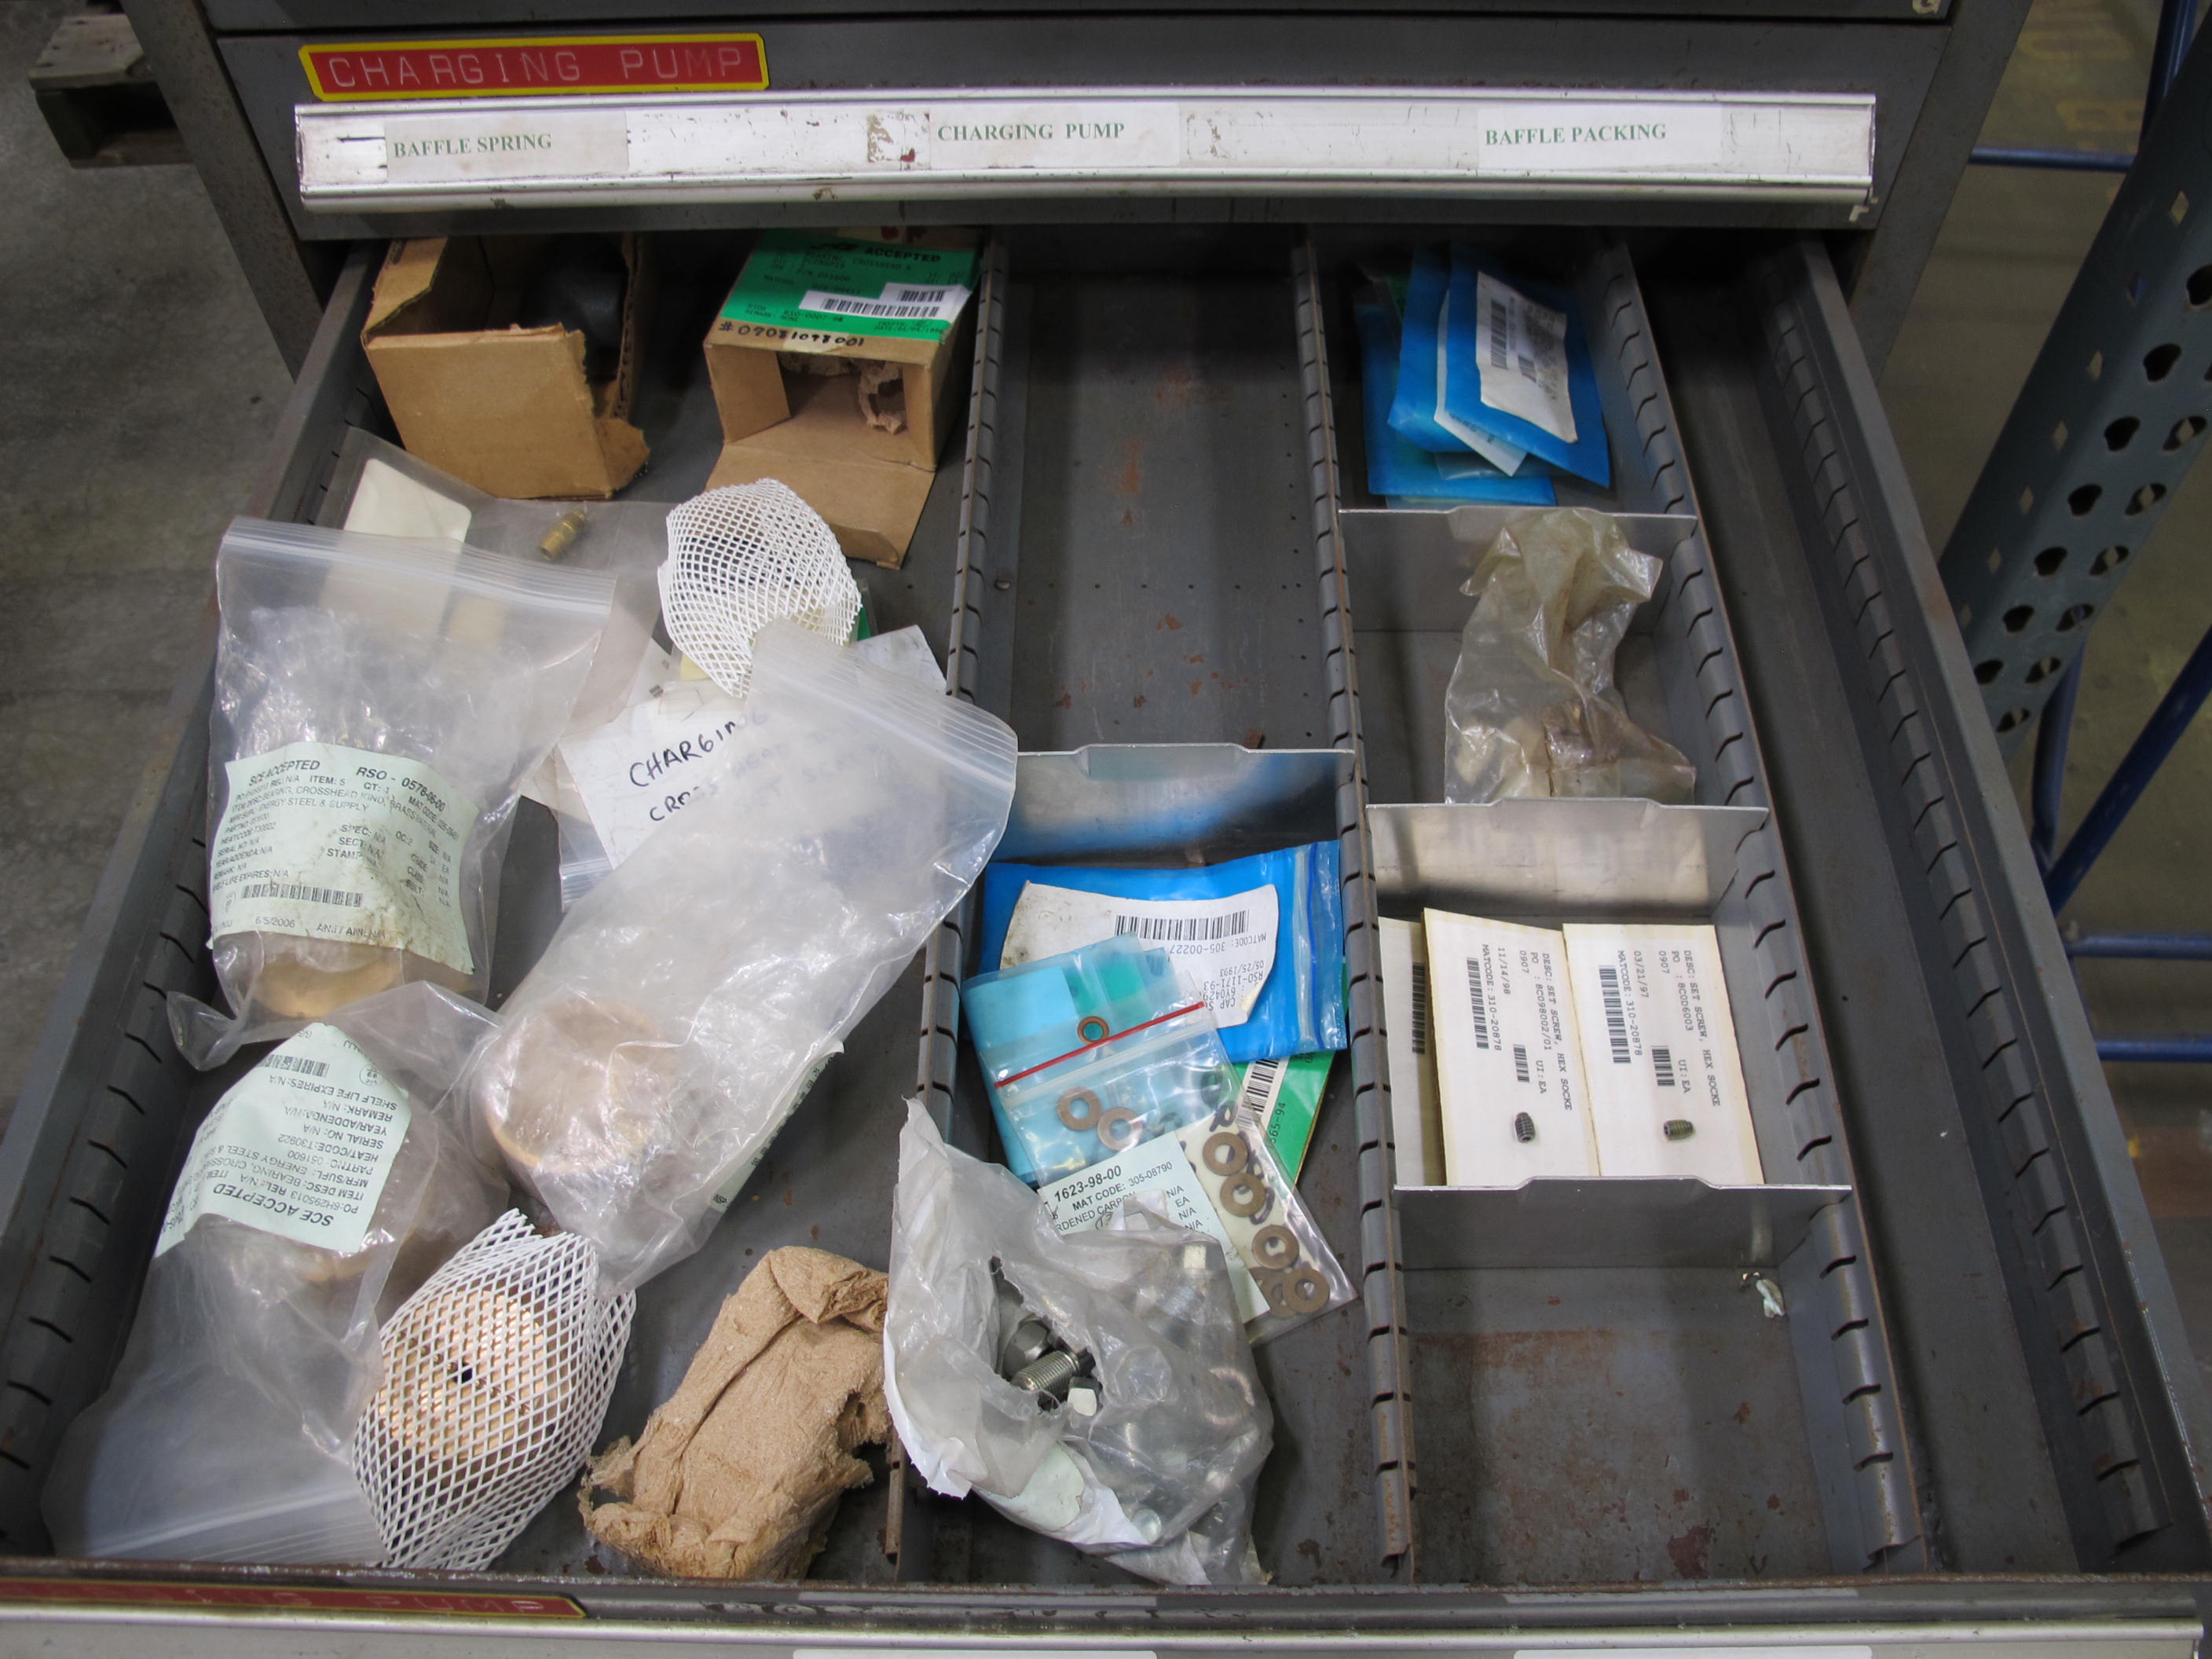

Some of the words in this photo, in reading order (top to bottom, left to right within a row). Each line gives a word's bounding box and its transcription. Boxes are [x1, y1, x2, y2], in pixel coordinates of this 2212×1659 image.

[328, 51, 580, 87] CHARGING
[621, 46, 742, 79] PUMP
[937, 123, 1053, 141] CHARGING
[1065, 122, 1126, 140] PUMP
[1485, 127, 1566, 146] BAFFLE
[1571, 123, 1666, 143] PACKING
[393, 137, 471, 158] BAFFLE
[476, 132, 552, 155] SPRING
[864, 246, 941, 263] ACCEPTED
[266, 760, 320, 779] ACCEPTED
[356, 767, 387, 781] RSO
[287, 797, 318, 808] STEEL
[1169, 941, 1226, 954] 305-00227
[1231, 932, 1267, 948] MATCODE:
[1518, 949, 1530, 974] 0907
[1530, 951, 1540, 964] PO
[1658, 950, 1670, 975] 0907
[1671, 950, 1680, 963] PO
[1219, 960, 1265, 977] 05/25/1993
[1497, 947, 1511, 995] 11/14/98
[1633, 950, 1650, 999] 03/21/97
[1203, 971, 1264, 991] RSO-1171-93
[1199, 986, 1236, 1001] 6Y0429
[1220, 998, 1236, 1009] CAP
[1550, 1009, 1563, 1046] SCREW,
[1694, 1005, 1708, 1042] SCREW,
[1557, 1053, 1567, 1073] HEX
[1702, 1049, 1714, 1069] HEX
[288, 1078, 335, 1097] EXPIRES:
[336, 1088, 361, 1102] LIFE
[1560, 1078, 1573, 1111] SOCKE
[1707, 1074, 1721, 1108] SOCKE
[361, 1095, 398, 1111] SHELF
[343, 1104, 393, 1123] REMARK:
[303, 1124, 321, 1136] N/A
[324, 1129, 344, 1141] NO:
[347, 1133, 384, 1150] SERIAL
[226, 1144, 260, 1160] STEEL
[260, 1155, 308, 1175] ENERGY
[251, 1162, 302, 1188] BEARING,
[1053, 1165, 1122, 1203] 1623-98-00
[304, 1181, 337, 1196] DESC:
[338, 1188, 365, 1201] ITEM
[1072, 1193, 1094, 1211] MAT
[1094, 1181, 1126, 1204] CODE:
[1128, 1161, 1174, 1188] 305-08790
[1166, 1184, 1185, 1199] N/A
[213, 1183, 299, 1217] ACCEPTED
[1174, 1195, 1191, 1208] EA
[299, 1209, 335, 1227] SCE
[1057, 1206, 1096, 1233] RDENED
[1177, 1207, 1197, 1221] N/A
